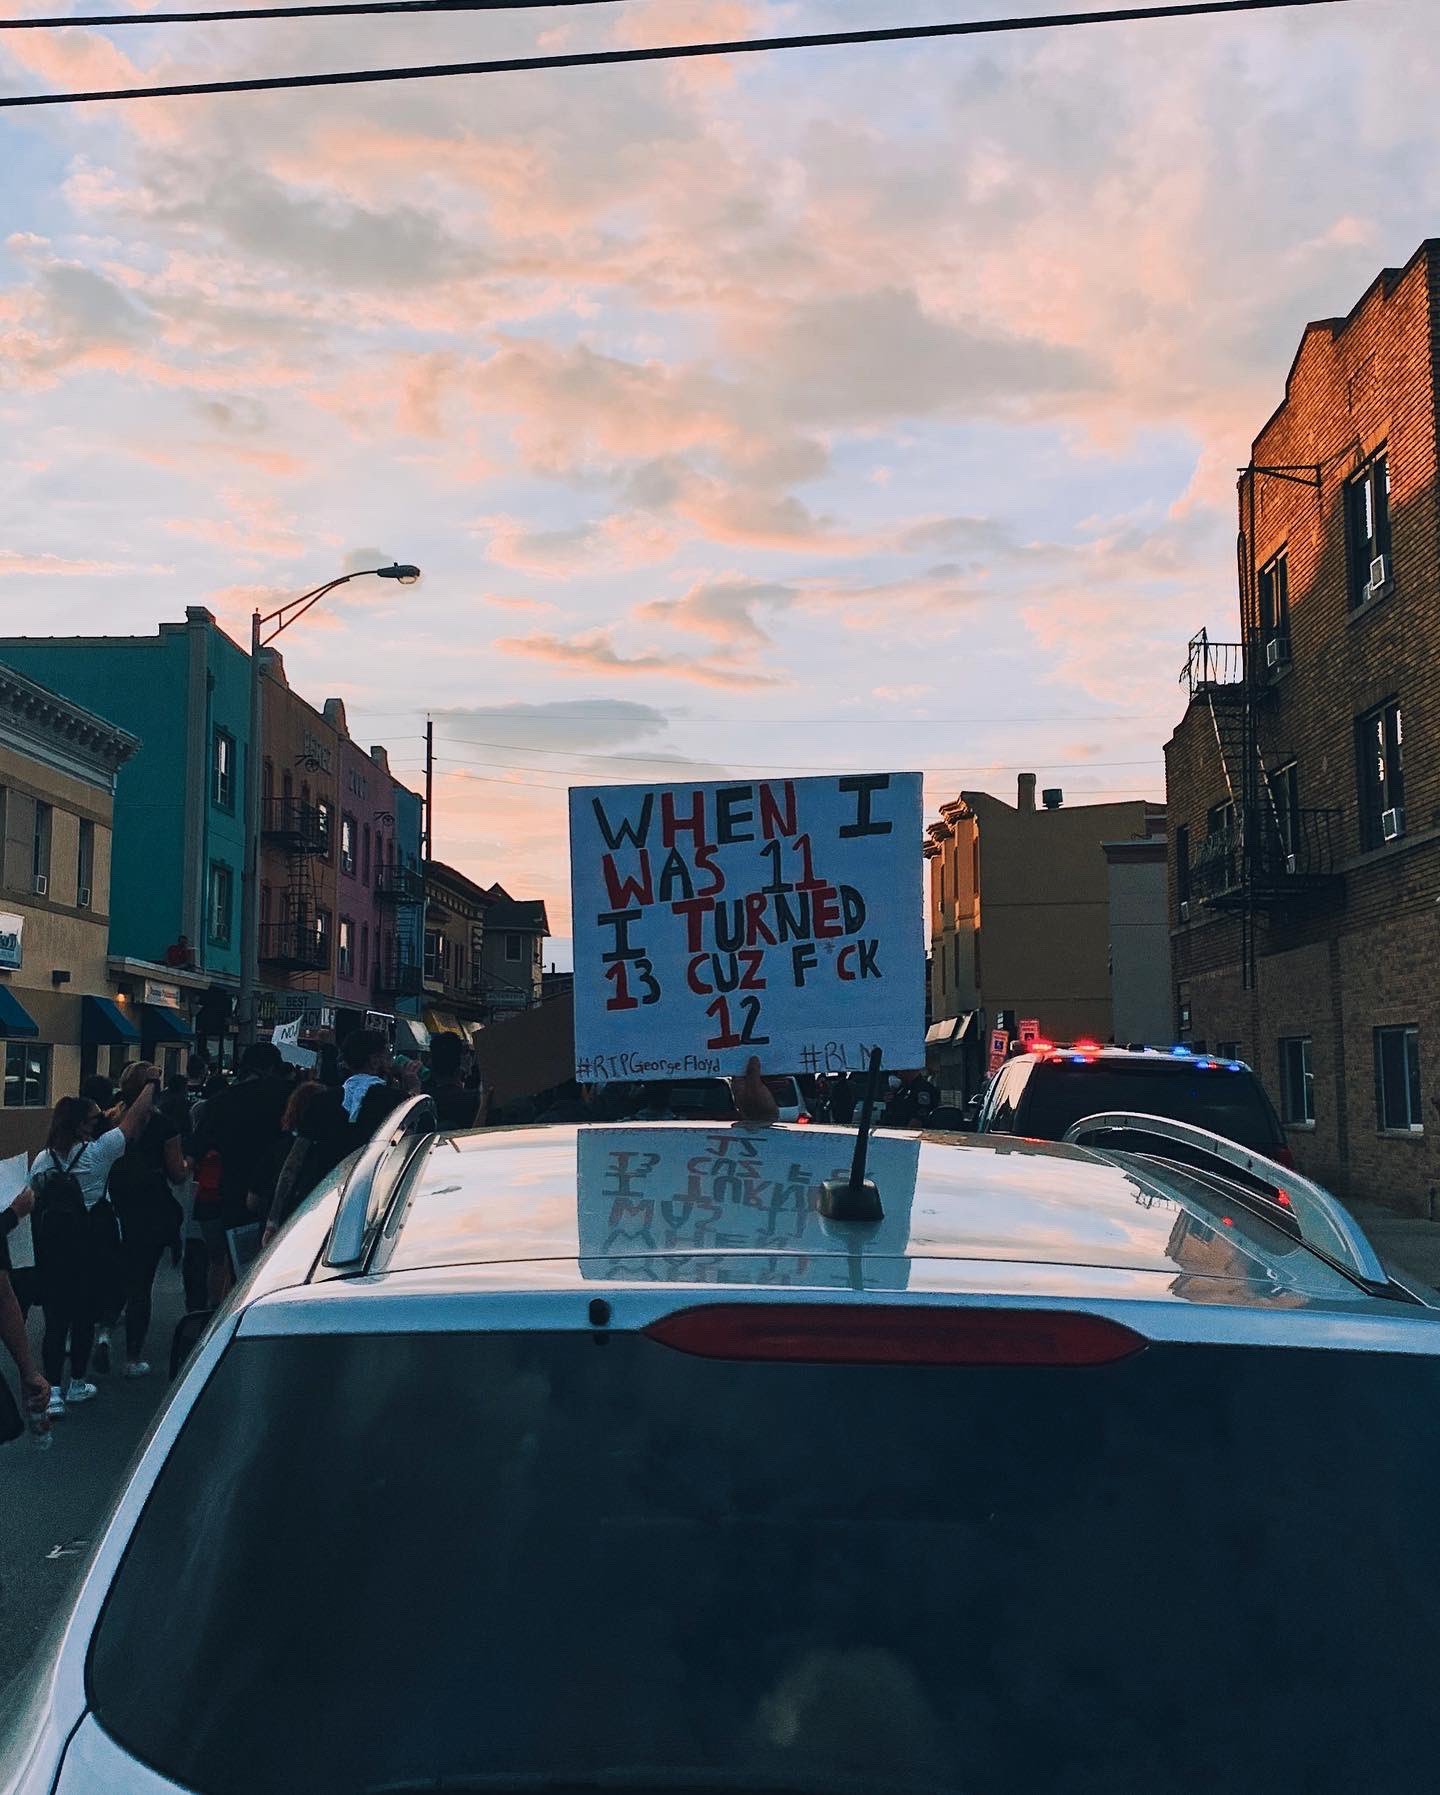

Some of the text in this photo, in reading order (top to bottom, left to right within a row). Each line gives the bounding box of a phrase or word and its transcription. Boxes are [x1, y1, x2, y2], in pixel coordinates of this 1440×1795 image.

[592, 774, 892, 850] WHEN I
[602, 833, 827, 910] WAS 11
[597, 885, 866, 963] I TURNED
[286, 996, 309, 1007] BEST
[604, 959, 661, 1011] 13
[687, 950, 766, 995] CUZ
[705, 996, 770, 1050] 12
